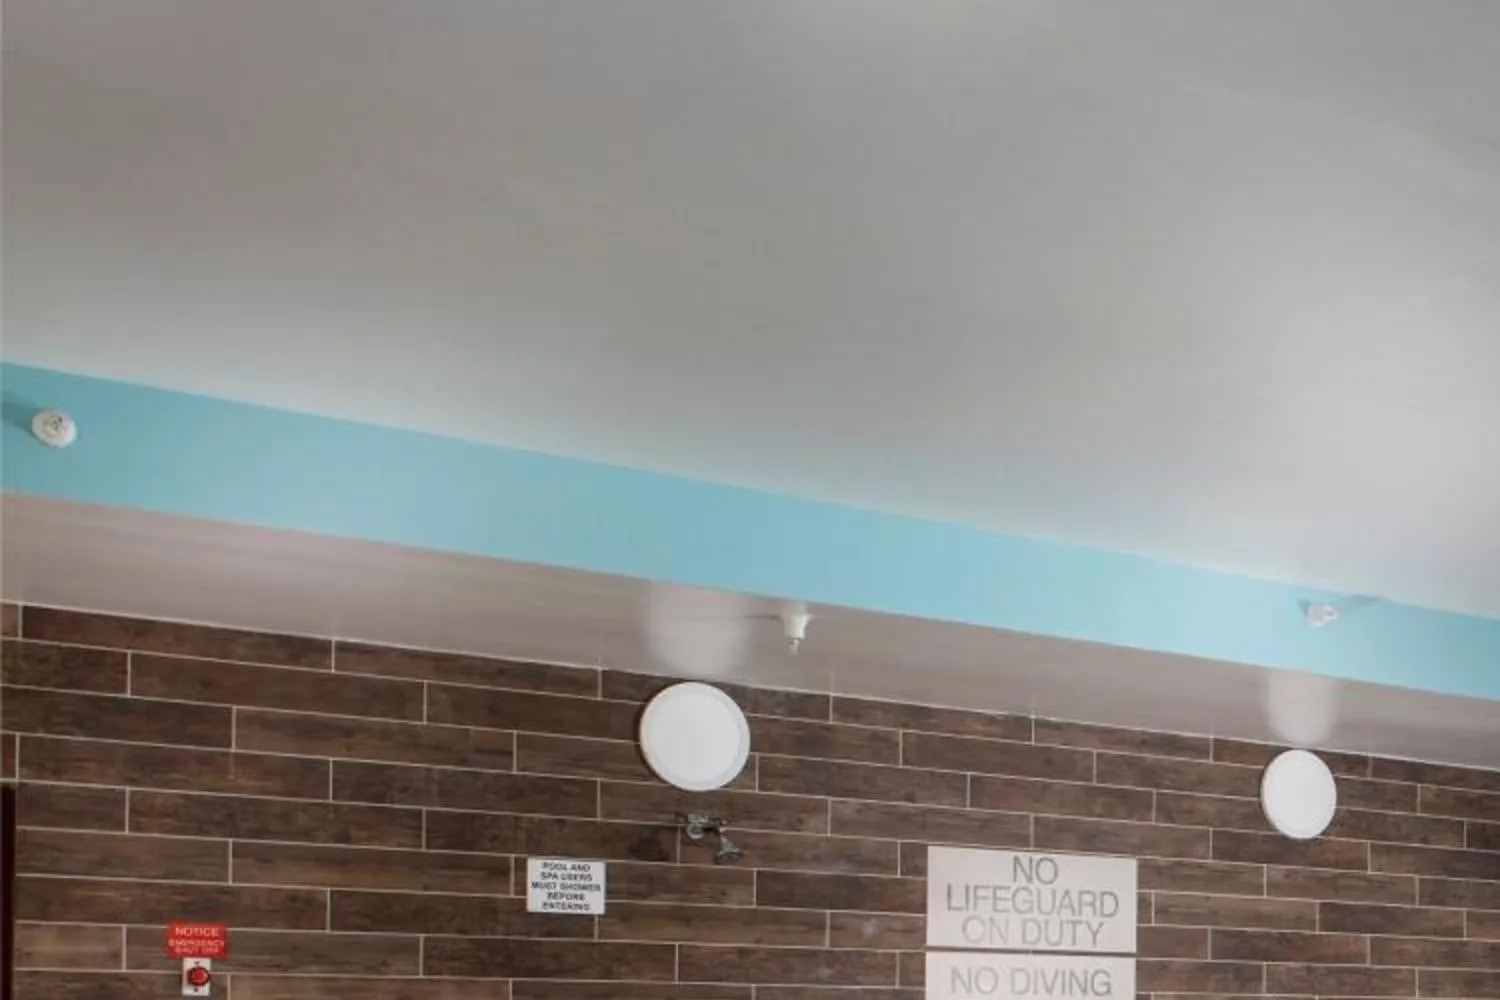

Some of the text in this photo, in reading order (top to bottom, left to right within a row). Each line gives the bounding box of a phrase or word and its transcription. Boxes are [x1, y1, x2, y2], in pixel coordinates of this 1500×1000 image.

[541, 872, 558, 880] SPA
[1011, 855, 1059, 885] NO
[946, 883, 1119, 918] LIFEGUARD
[175, 927, 220, 937] NOTICE
[961, 915, 1104, 947] ON DUTY
[950, 966, 1112, 997] NO DIVING
